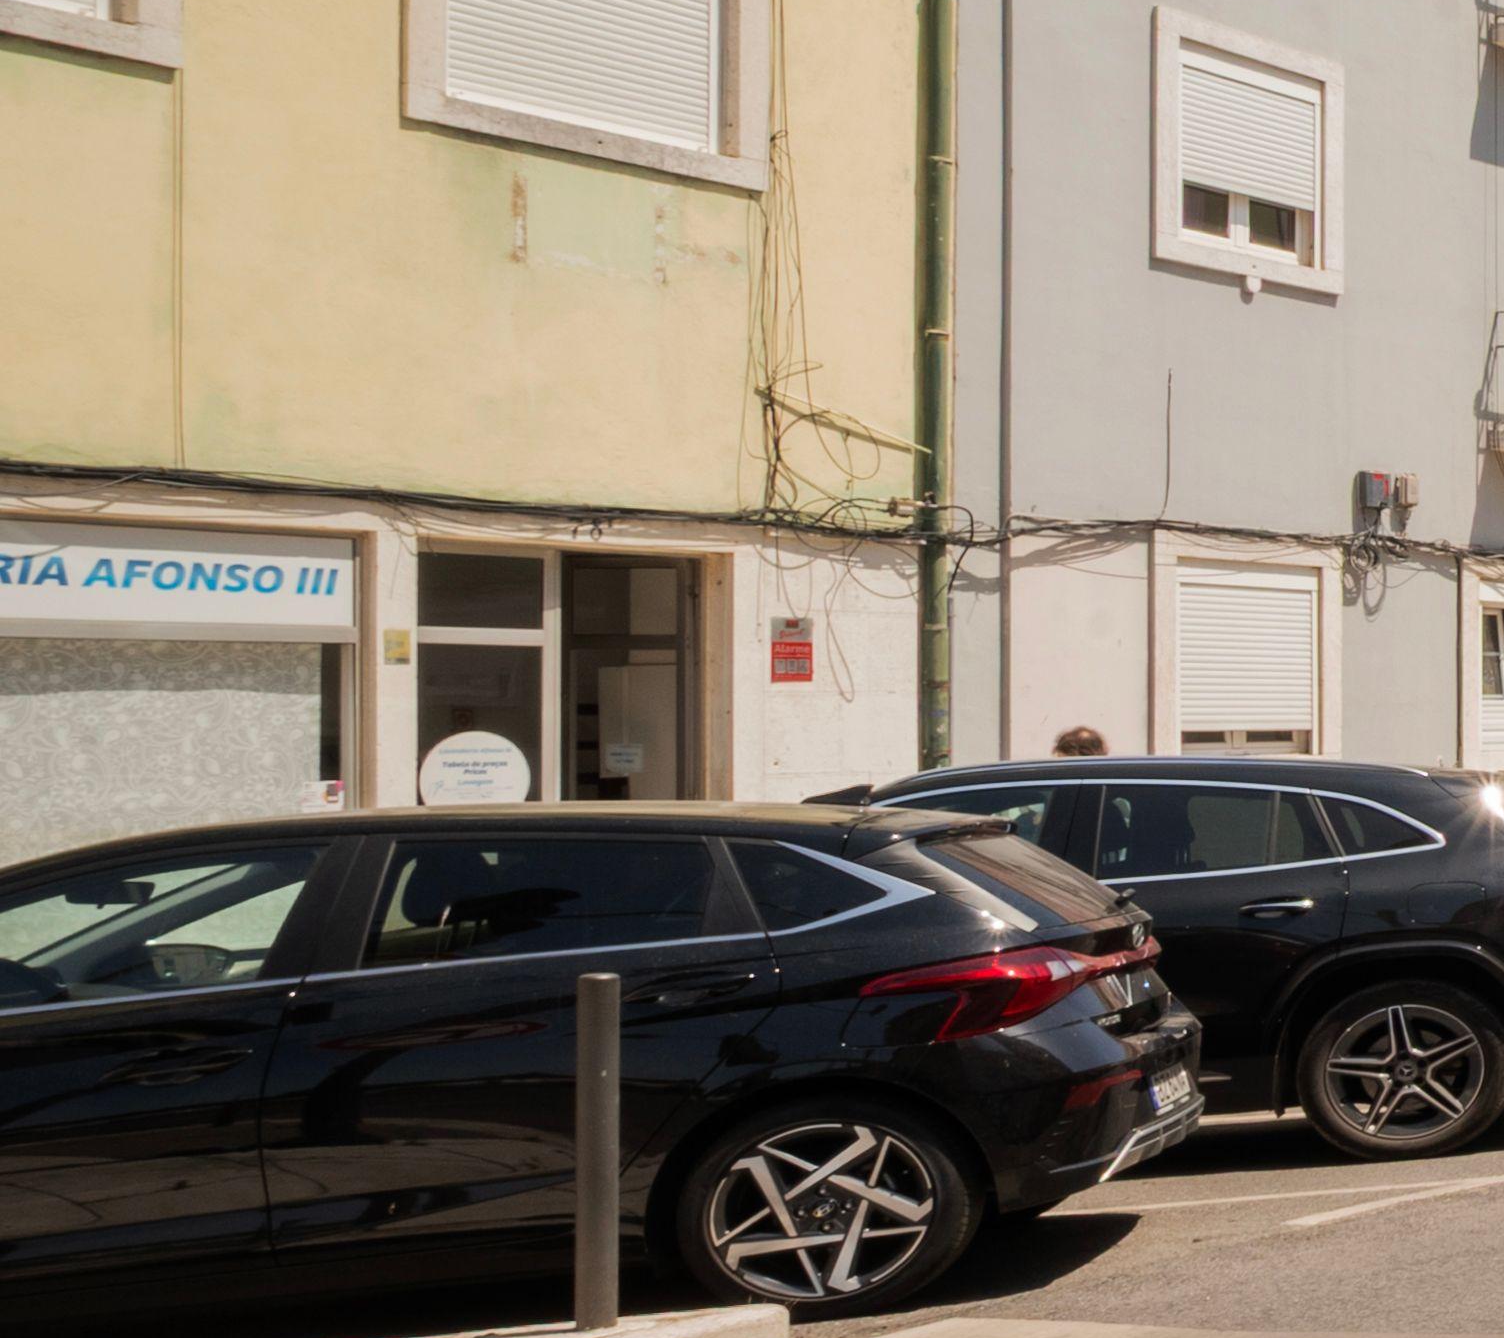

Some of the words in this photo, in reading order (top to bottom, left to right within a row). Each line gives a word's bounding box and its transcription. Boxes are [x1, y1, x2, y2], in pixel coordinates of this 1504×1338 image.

[82, 558, 284, 593] AFONSO
[296, 567, 338, 595] III
[775, 644, 811, 653] Alarme
